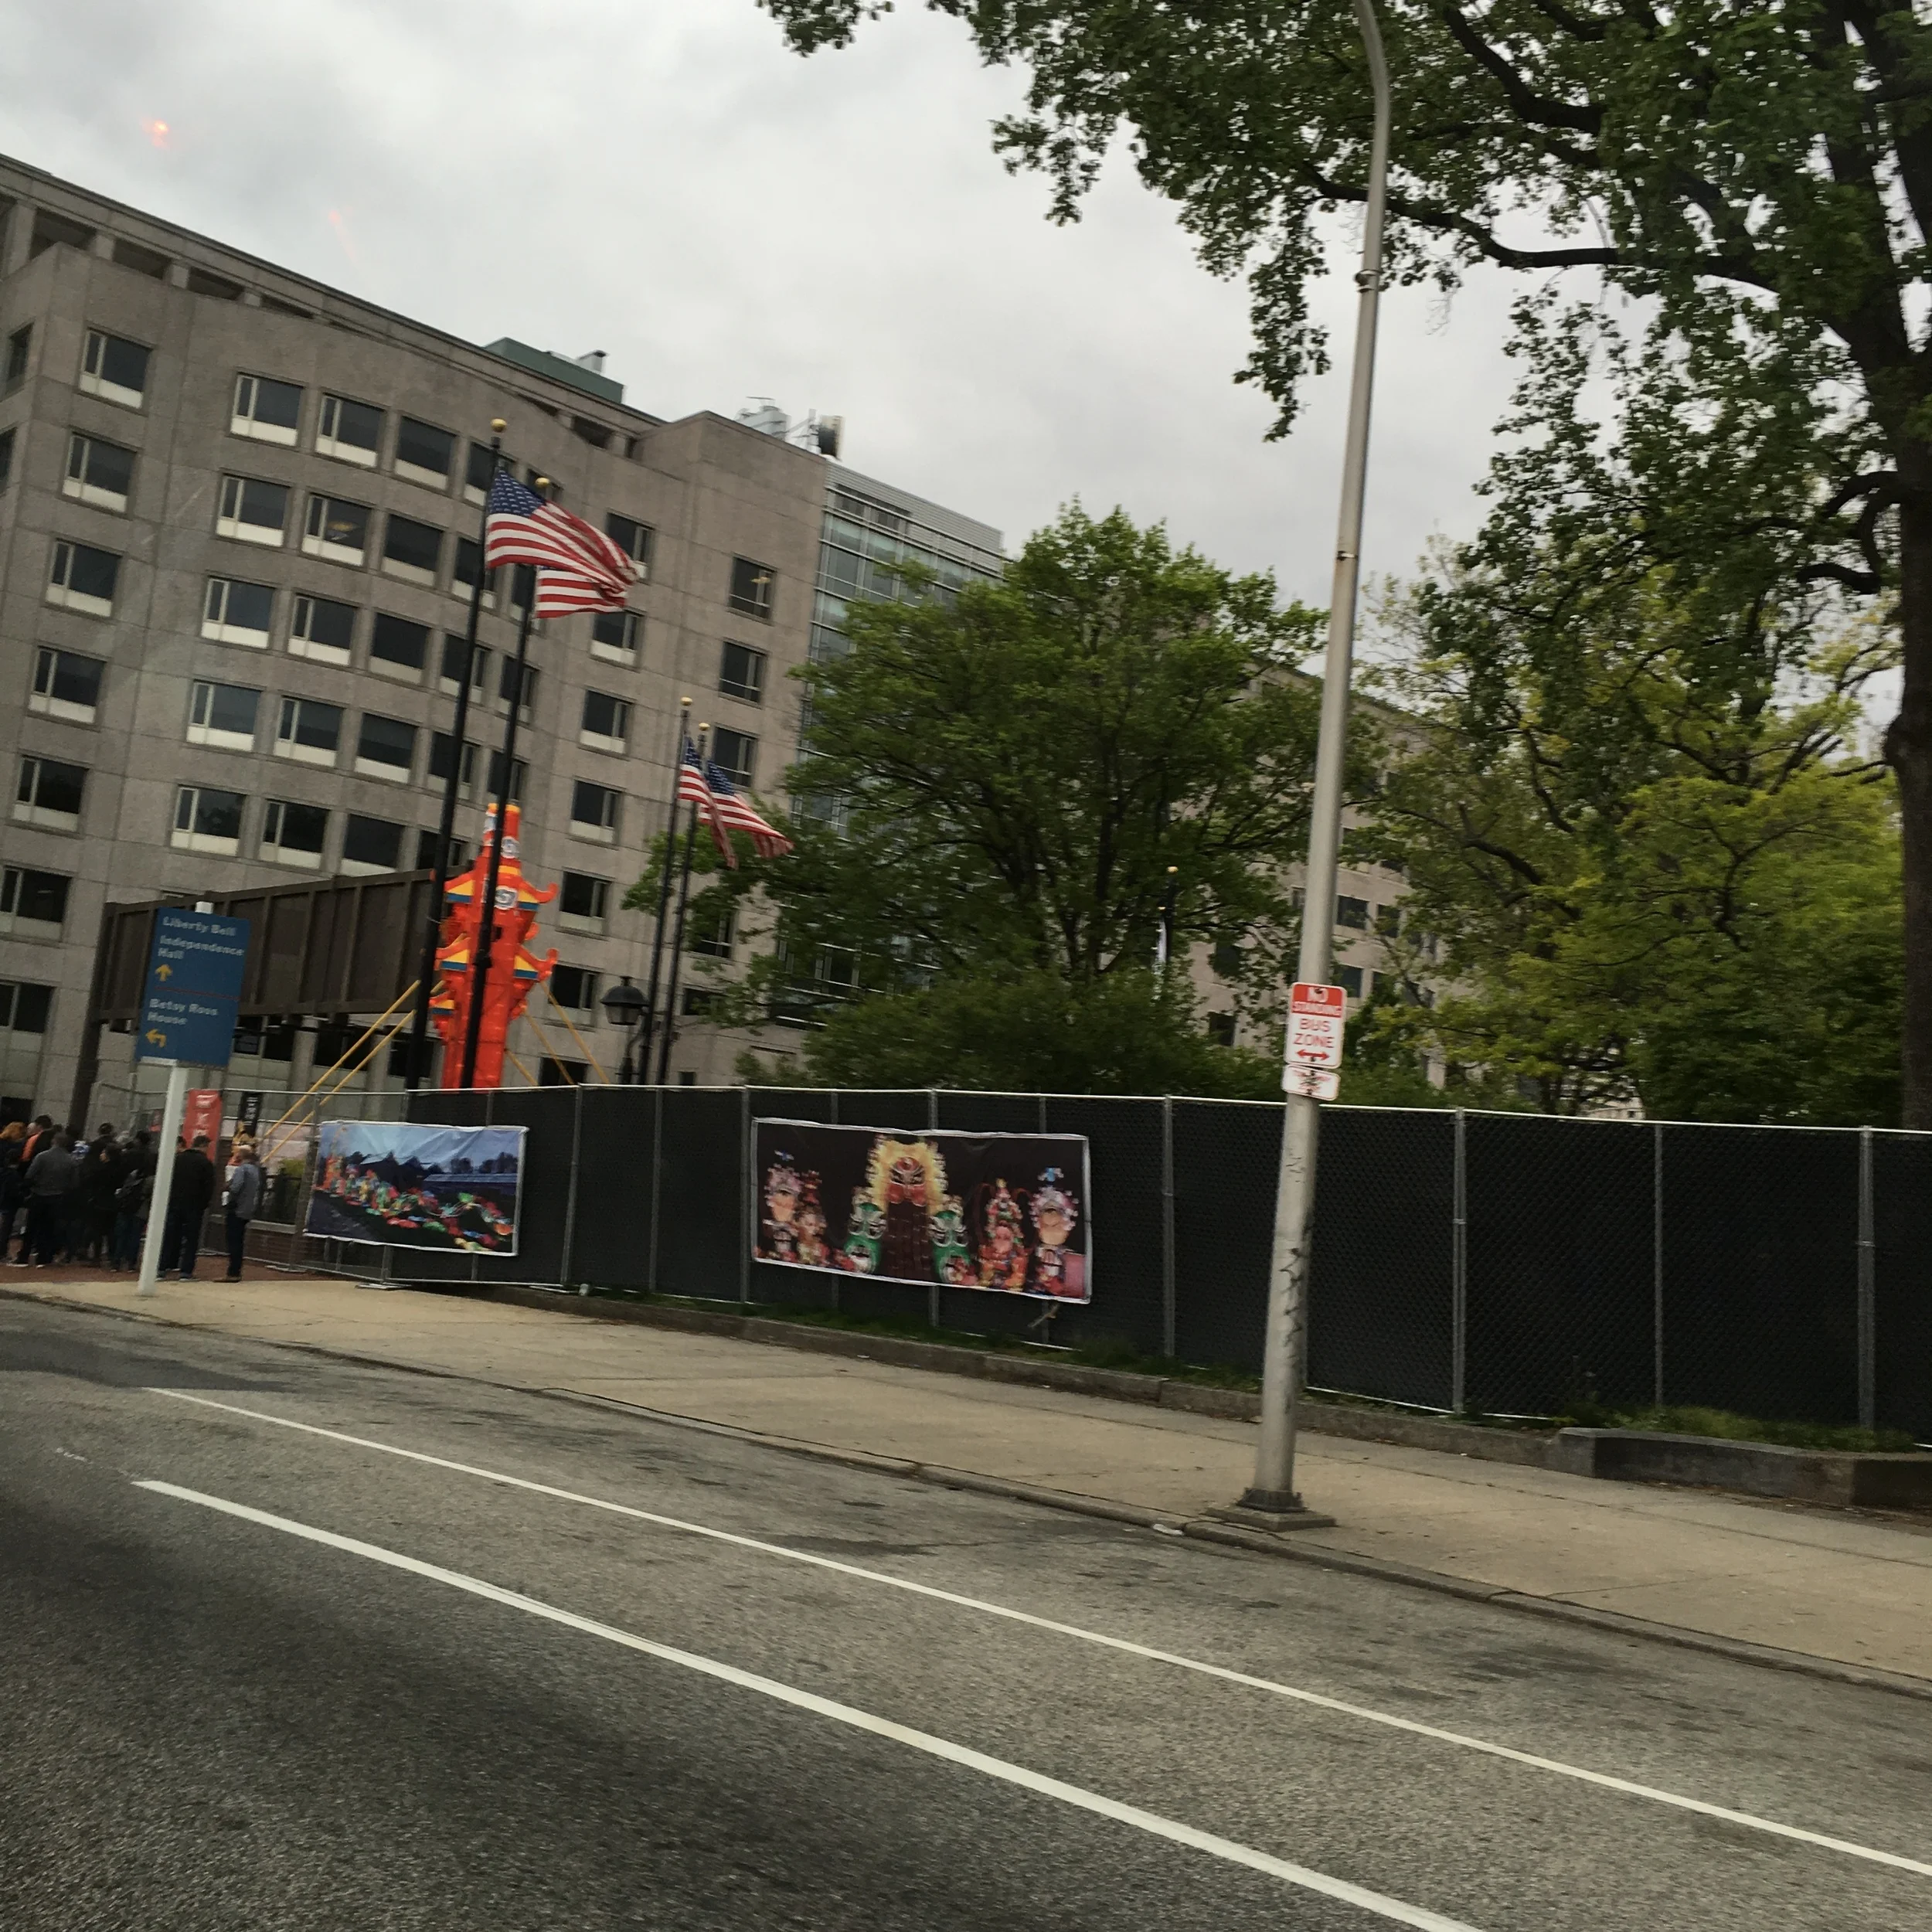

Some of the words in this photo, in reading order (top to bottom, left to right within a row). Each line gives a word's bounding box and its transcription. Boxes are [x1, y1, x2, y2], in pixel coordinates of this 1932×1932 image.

[163, 916, 209, 934] Liberty
[211, 924, 236, 937] Bell
[158, 947, 185, 960] Hall
[160, 935, 245, 956] Independence
[149, 998, 185, 1012] Betsy
[189, 1004, 219, 1016] Ross
[147, 1012, 188, 1025] House
[1300, 1019, 1332, 1032] BUS
[1294, 1033, 1335, 1049] ZONE
